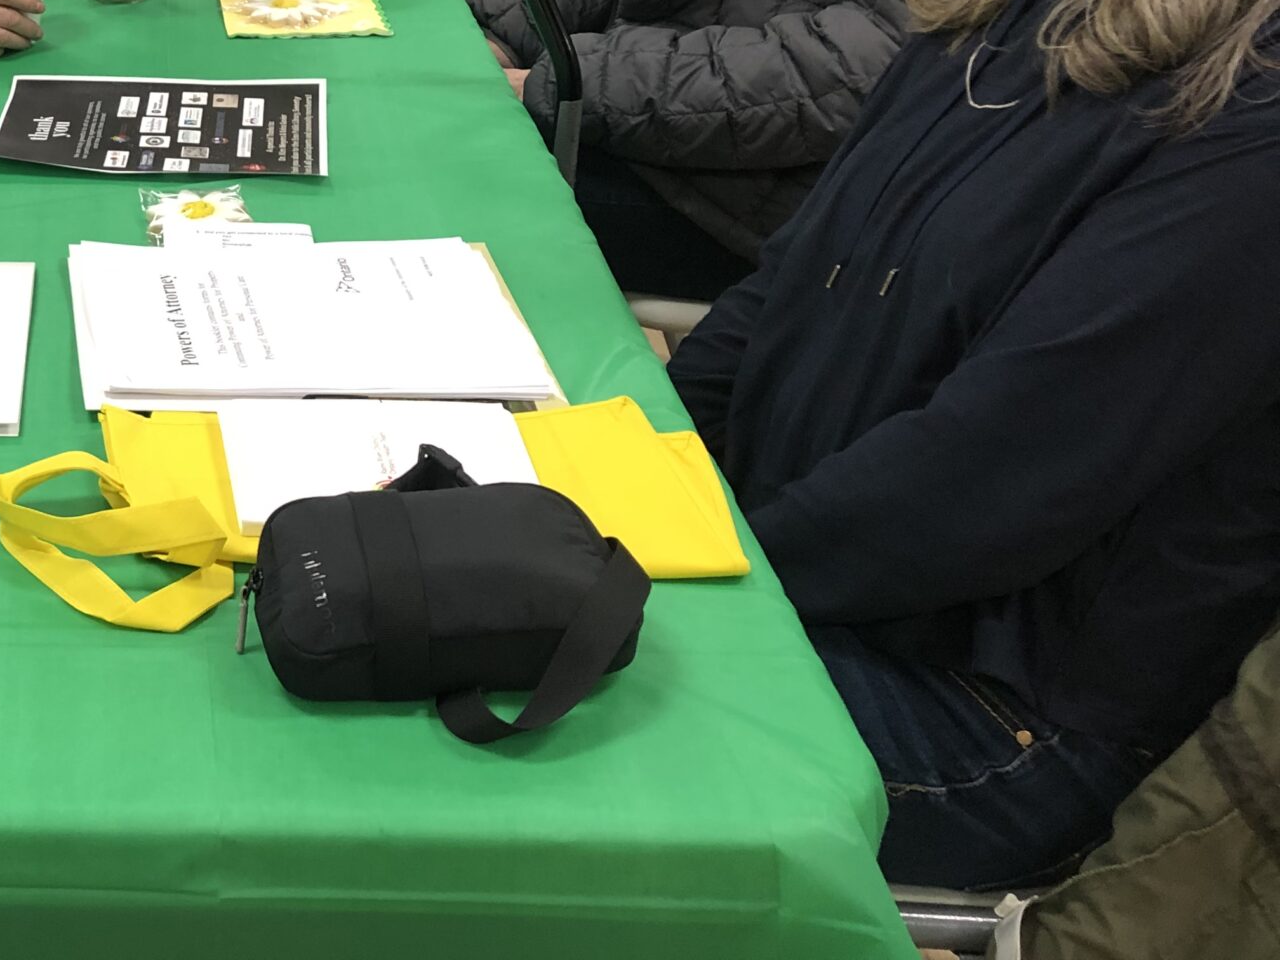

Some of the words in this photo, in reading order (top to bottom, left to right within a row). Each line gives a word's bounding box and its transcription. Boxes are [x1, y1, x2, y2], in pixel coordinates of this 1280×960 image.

[28, 116, 55, 141] thank
[52, 121, 71, 138] you
[337, 257, 356, 281] Ontario
[160, 274, 184, 316] Attorney
[167, 318, 187, 329] of
[177, 331, 200, 366] Powers
